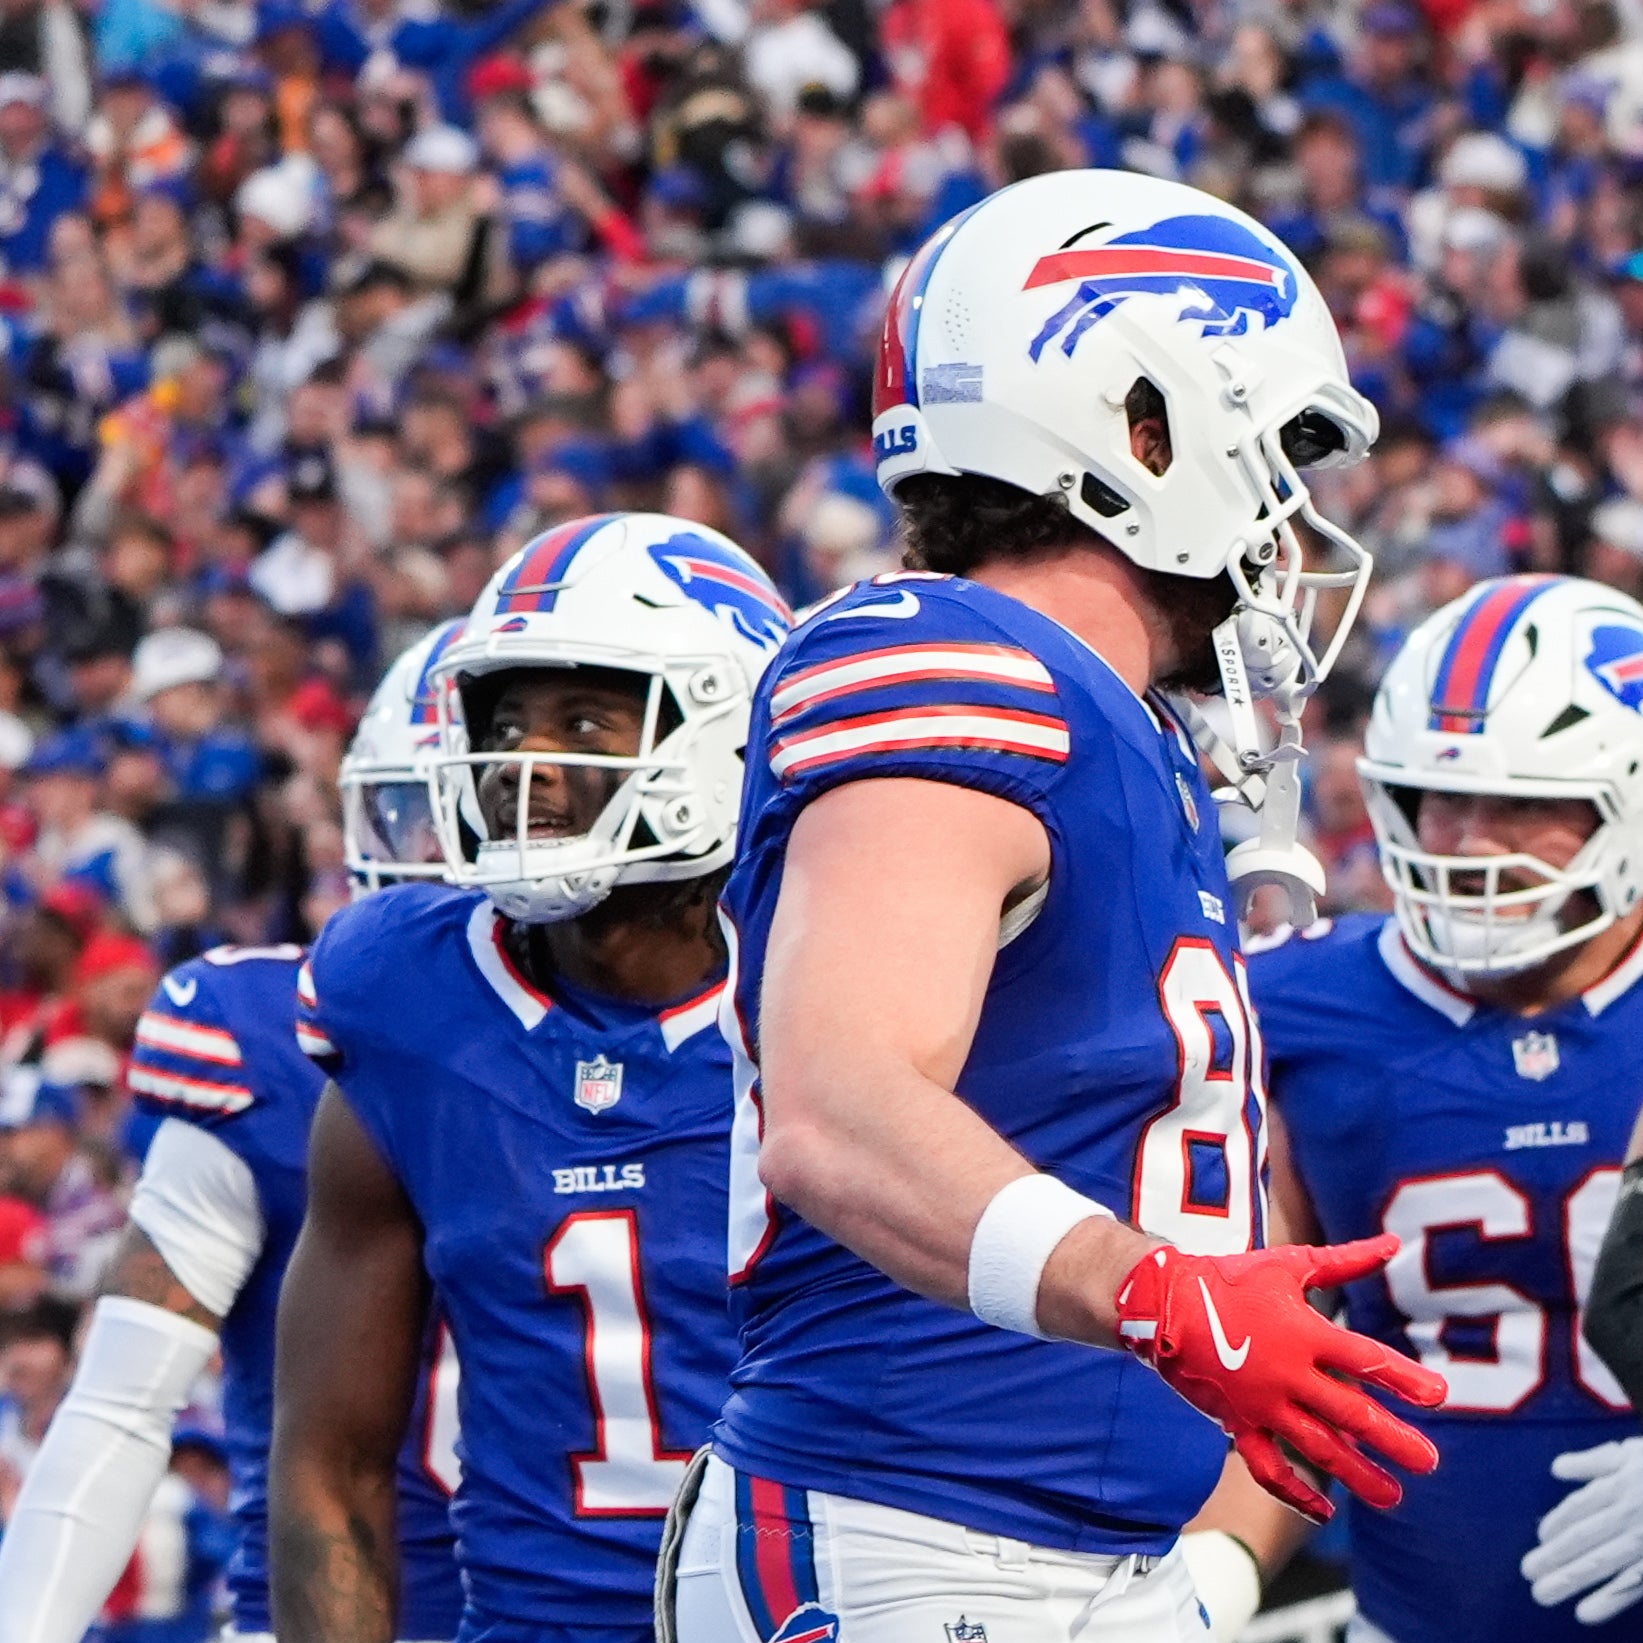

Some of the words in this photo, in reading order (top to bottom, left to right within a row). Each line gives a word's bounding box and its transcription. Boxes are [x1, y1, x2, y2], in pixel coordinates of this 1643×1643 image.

[552, 1163, 646, 1194] BILLS
[1132, 936, 1266, 1258] 8
[543, 1210, 692, 1518] 1
